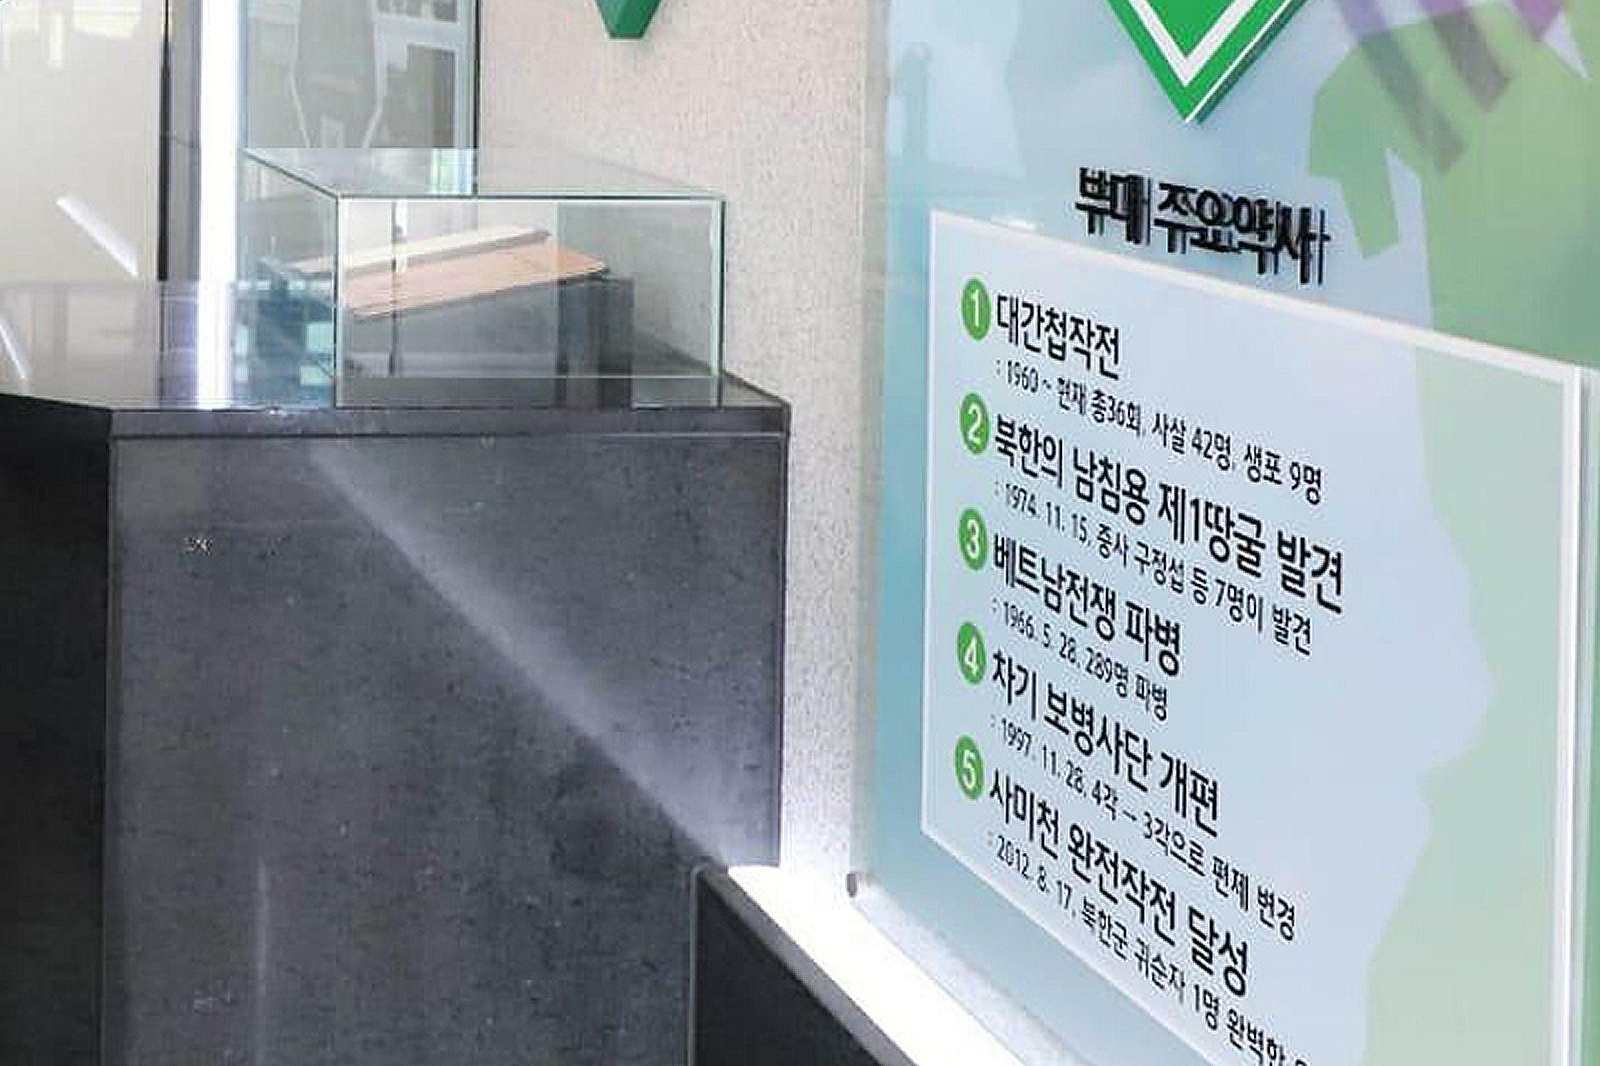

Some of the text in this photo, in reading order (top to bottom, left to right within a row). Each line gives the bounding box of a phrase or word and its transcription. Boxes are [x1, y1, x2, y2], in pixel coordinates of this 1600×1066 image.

[996, 294, 1121, 380] 대간첩작전
[1057, 377, 1087, 416] 현재
[1151, 412, 1187, 455] 사살
[1243, 443, 1283, 485] 생포
[1289, 460, 1323, 506] 9명
[995, 414, 1065, 488] 북한의
[1072, 446, 1150, 526] 남침용
[1158, 481, 1266, 578] 제1땅굴
[1277, 530, 1344, 614] 발견
[993, 533, 1118, 642] 베트남전쟁
[1124, 600, 1182, 677] 파병
[1097, 523, 1130, 569] 중사
[1134, 540, 1185, 595] 구정섭
[1190, 565, 1209, 606] 등
[1213, 578, 1264, 633] 7명이
[1272, 603, 1312, 657] 발견
[992, 648, 1038, 721] 차기
[1043, 682, 1153, 793] 보병사단
[1159, 750, 1218, 838] 개편
[1085, 647, 1130, 698] 289명
[1135, 673, 1168, 722] 파병
[988, 767, 1060, 860] 사미천
[1067, 822, 1177, 947] 완전작전
[1187, 905, 1248, 997] 달성
[1142, 811, 1206, 877] 3각으로
[1212, 855, 1250, 912] 편제
[1257, 886, 1295, 941] 변경
[1134, 937, 1186, 1004] 귀순자
[1194, 984, 1219, 1031] 1명
